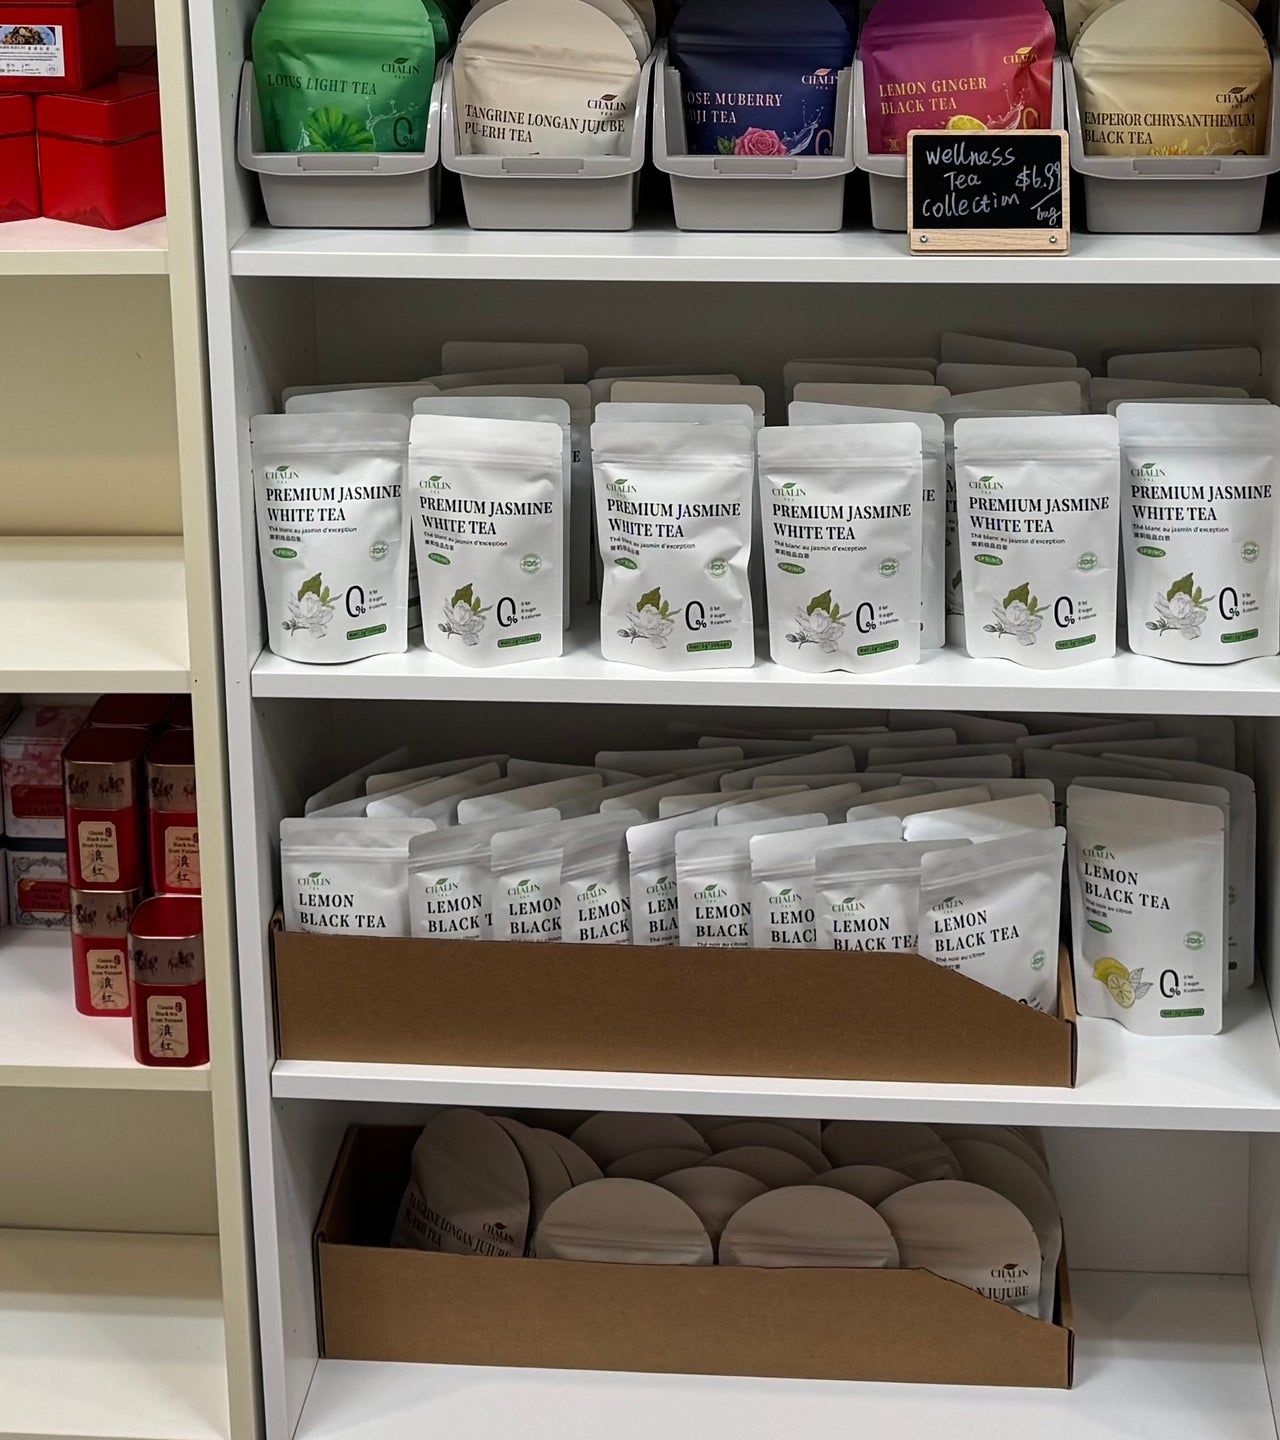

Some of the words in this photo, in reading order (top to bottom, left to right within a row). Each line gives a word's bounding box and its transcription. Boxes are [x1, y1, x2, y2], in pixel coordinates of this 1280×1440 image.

[381, 62, 420, 74] CHALIN
[267, 74, 301, 90] LOTUS
[306, 77, 348, 94] LIGHT
[353, 80, 377, 95] TEA
[879, 80, 926, 97] LEMON
[931, 77, 987, 93] GINGER
[684, 92, 711, 105] OSE
[715, 93, 783, 107] MUBERRY
[881, 99, 925, 115] BLACK
[931, 98, 957, 112] TEA
[465, 104, 524, 127] TANGRINE
[528, 111, 577, 130] LONGAN
[579, 116, 625, 133] JUJUBE
[711, 111, 736, 123] TEA
[1084, 111, 1141, 127] EMPEROR
[1144, 111, 1256, 128] CHRYSANTHEMUM
[465, 123, 506, 143] PU-ERH
[510, 127, 533, 143] TEA
[1084, 130, 1123, 145] BLACK
[1126, 130, 1153, 145] TEA
[944, 171, 982, 190] Tea
[969, 496, 1042, 513] PREMIUM
[1044, 496, 1109, 515] JASMINE
[970, 516, 1021, 533] WHITE
[1024, 519, 1054, 533] TEA
[1084, 864, 1139, 887] LEMON
[299, 892, 354, 909] LEMON
[1084, 882, 1134, 905] BLACK
[1139, 891, 1171, 911] TEA
[300, 912, 349, 928] BLACK
[355, 914, 387, 929] TEA
